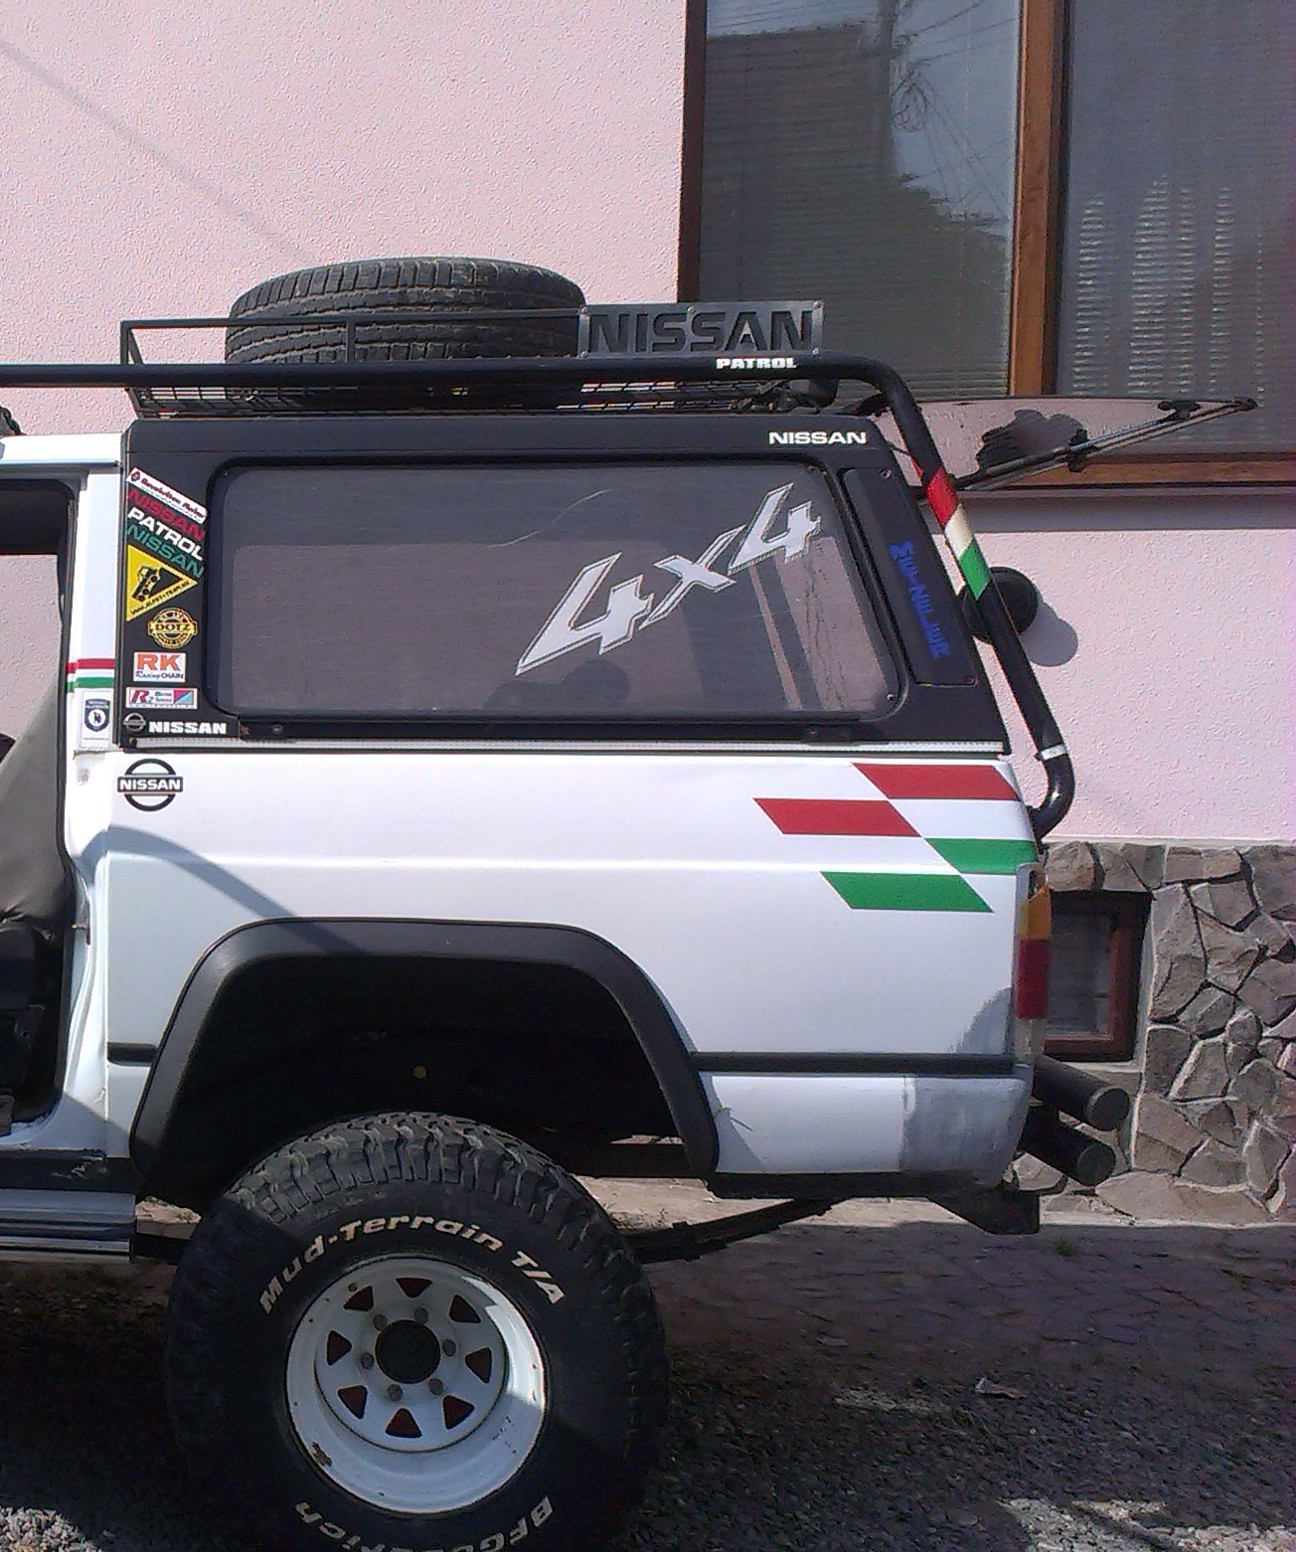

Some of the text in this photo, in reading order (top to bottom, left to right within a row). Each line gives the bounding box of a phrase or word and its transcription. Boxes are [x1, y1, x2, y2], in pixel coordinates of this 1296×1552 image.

[589, 309, 813, 352] NISSAN
[716, 357, 797, 370] PATROL
[768, 431, 867, 445] NISSAN
[127, 487, 205, 540] NISSAN
[127, 506, 203, 561] PATROL
[127, 523, 204, 578] NISSAN
[136, 653, 182, 671] RK
[149, 721, 227, 735] NISSAN
[119, 777, 181, 791] NISSAN
[258, 1214, 567, 1315] Mud-Terrain T/A
[295, 1495, 555, 1552] BFGorich
